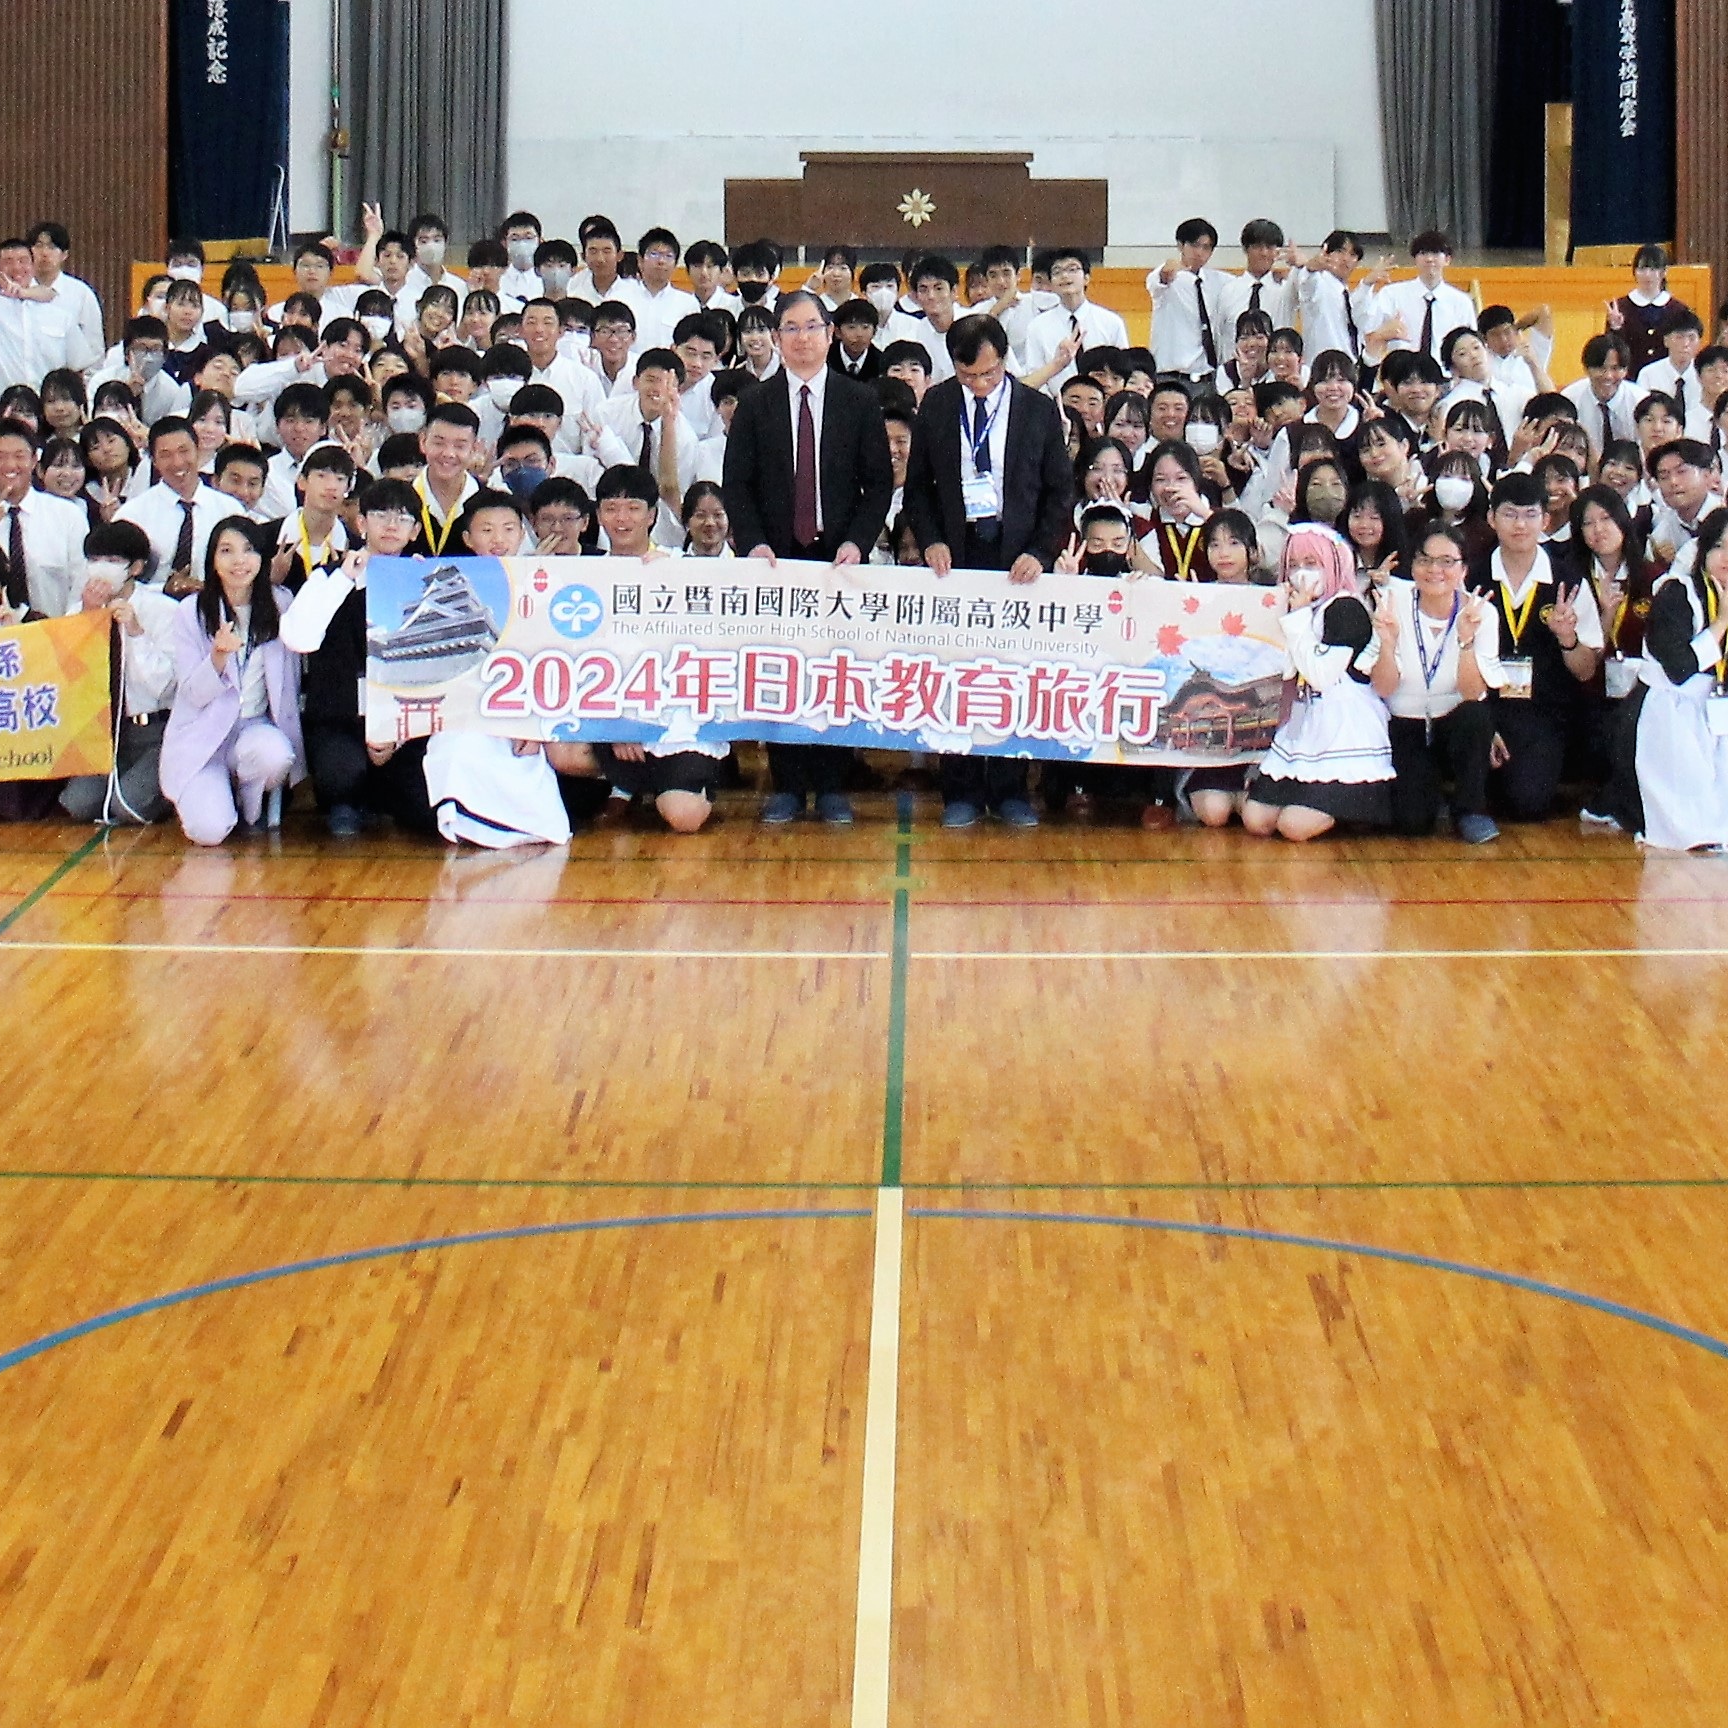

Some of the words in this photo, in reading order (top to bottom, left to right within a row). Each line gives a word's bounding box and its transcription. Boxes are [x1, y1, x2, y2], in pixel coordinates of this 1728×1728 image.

[612, 584, 1103, 635] 國立暨南國際大學附屬高級中學
[612, 621, 639, 635] The
[644, 621, 713, 636] Affiliated
[719, 622, 765, 636] Senior
[771, 623, 806, 641] High
[811, 624, 862, 642] School
[865, 629, 881, 642] of
[885, 629, 950, 647] National
[955, 633, 1017, 650] Chi-Nan
[1022, 635, 1100, 658] University
[485, 651, 1165, 740] 2024年日本教育旅行
